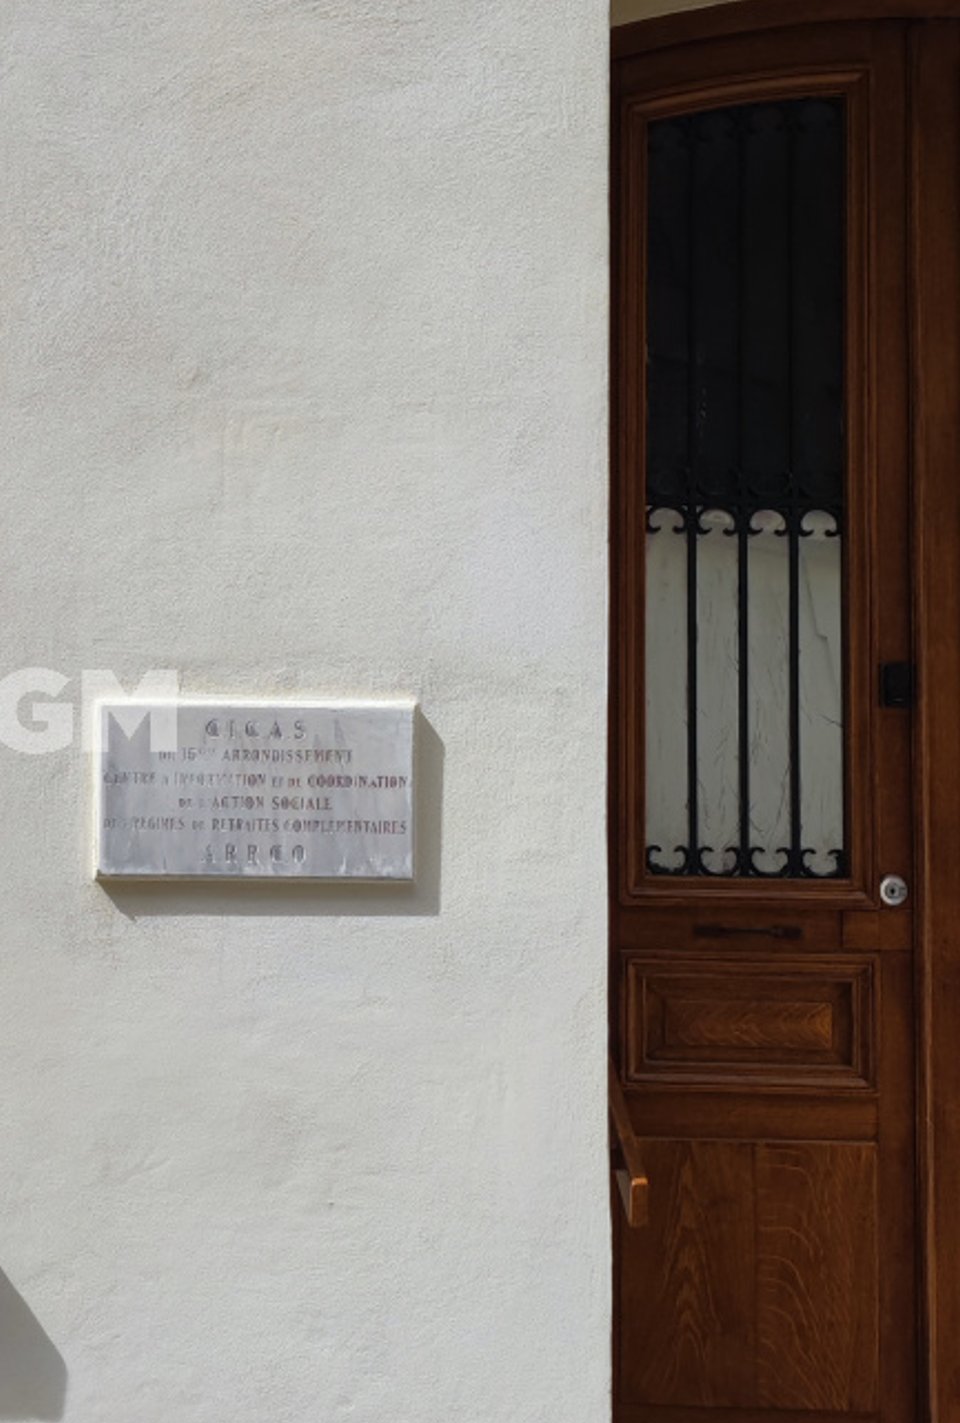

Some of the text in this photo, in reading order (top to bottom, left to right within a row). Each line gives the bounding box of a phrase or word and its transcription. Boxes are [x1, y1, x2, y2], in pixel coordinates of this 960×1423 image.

[221, 748, 352, 763] ARRONDISSEMENT
[307, 775, 408, 788] COORDINATION
[271, 796, 333, 810] SOCIALE
[212, 817, 279, 832] RETRAITES
